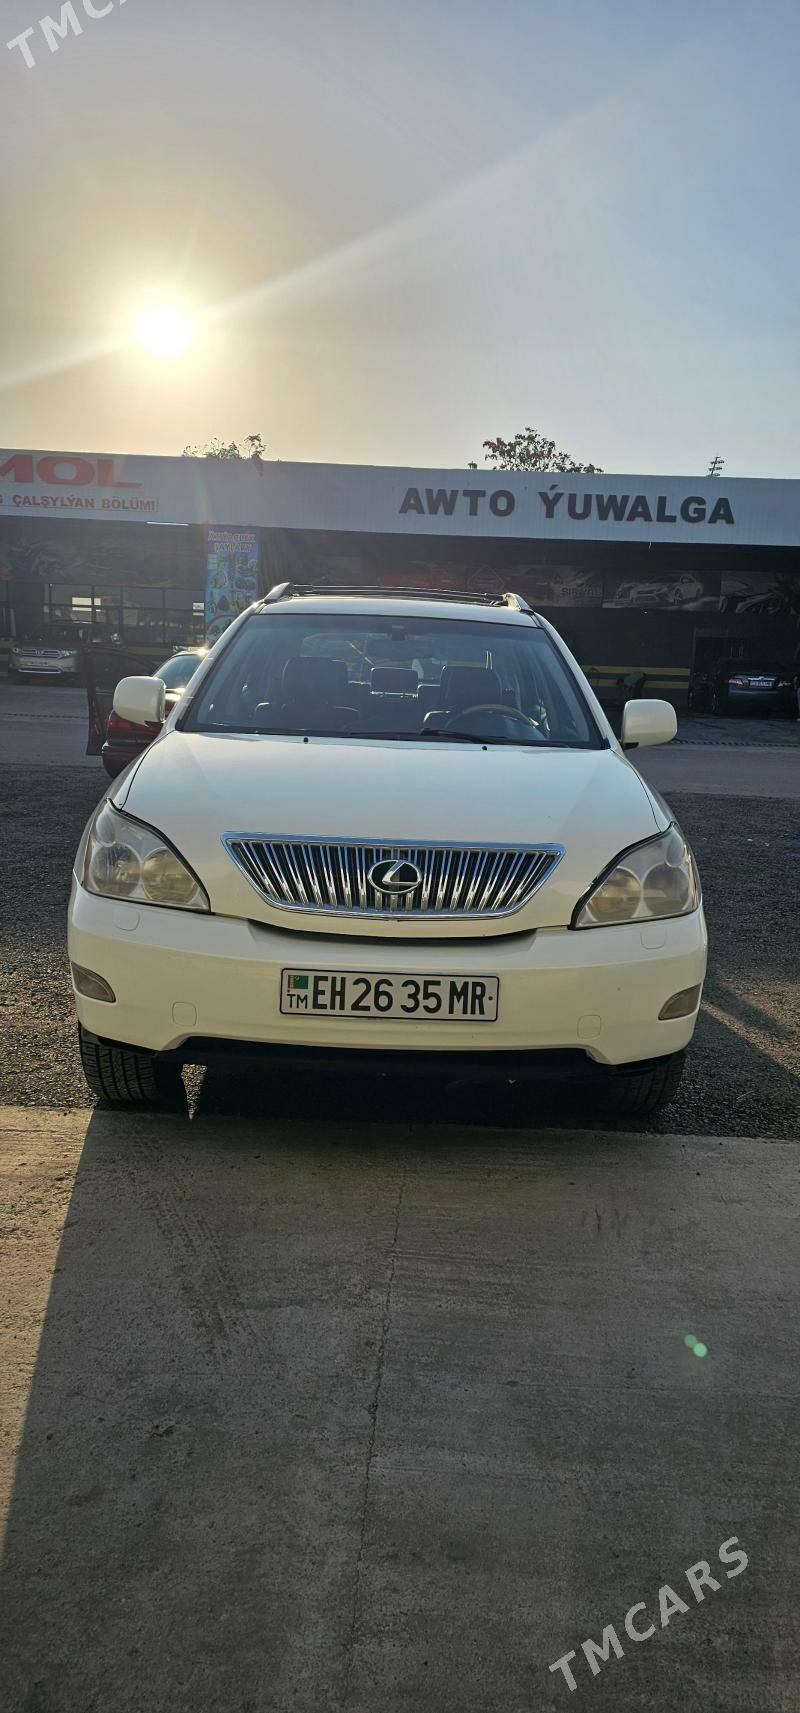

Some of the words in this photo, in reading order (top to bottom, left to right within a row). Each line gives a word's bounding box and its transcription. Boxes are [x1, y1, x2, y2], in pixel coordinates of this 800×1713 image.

[399, 487, 515, 517] AWTO
[537, 483, 735, 525] ÝUWALGA
[286, 994, 308, 1009] TM
